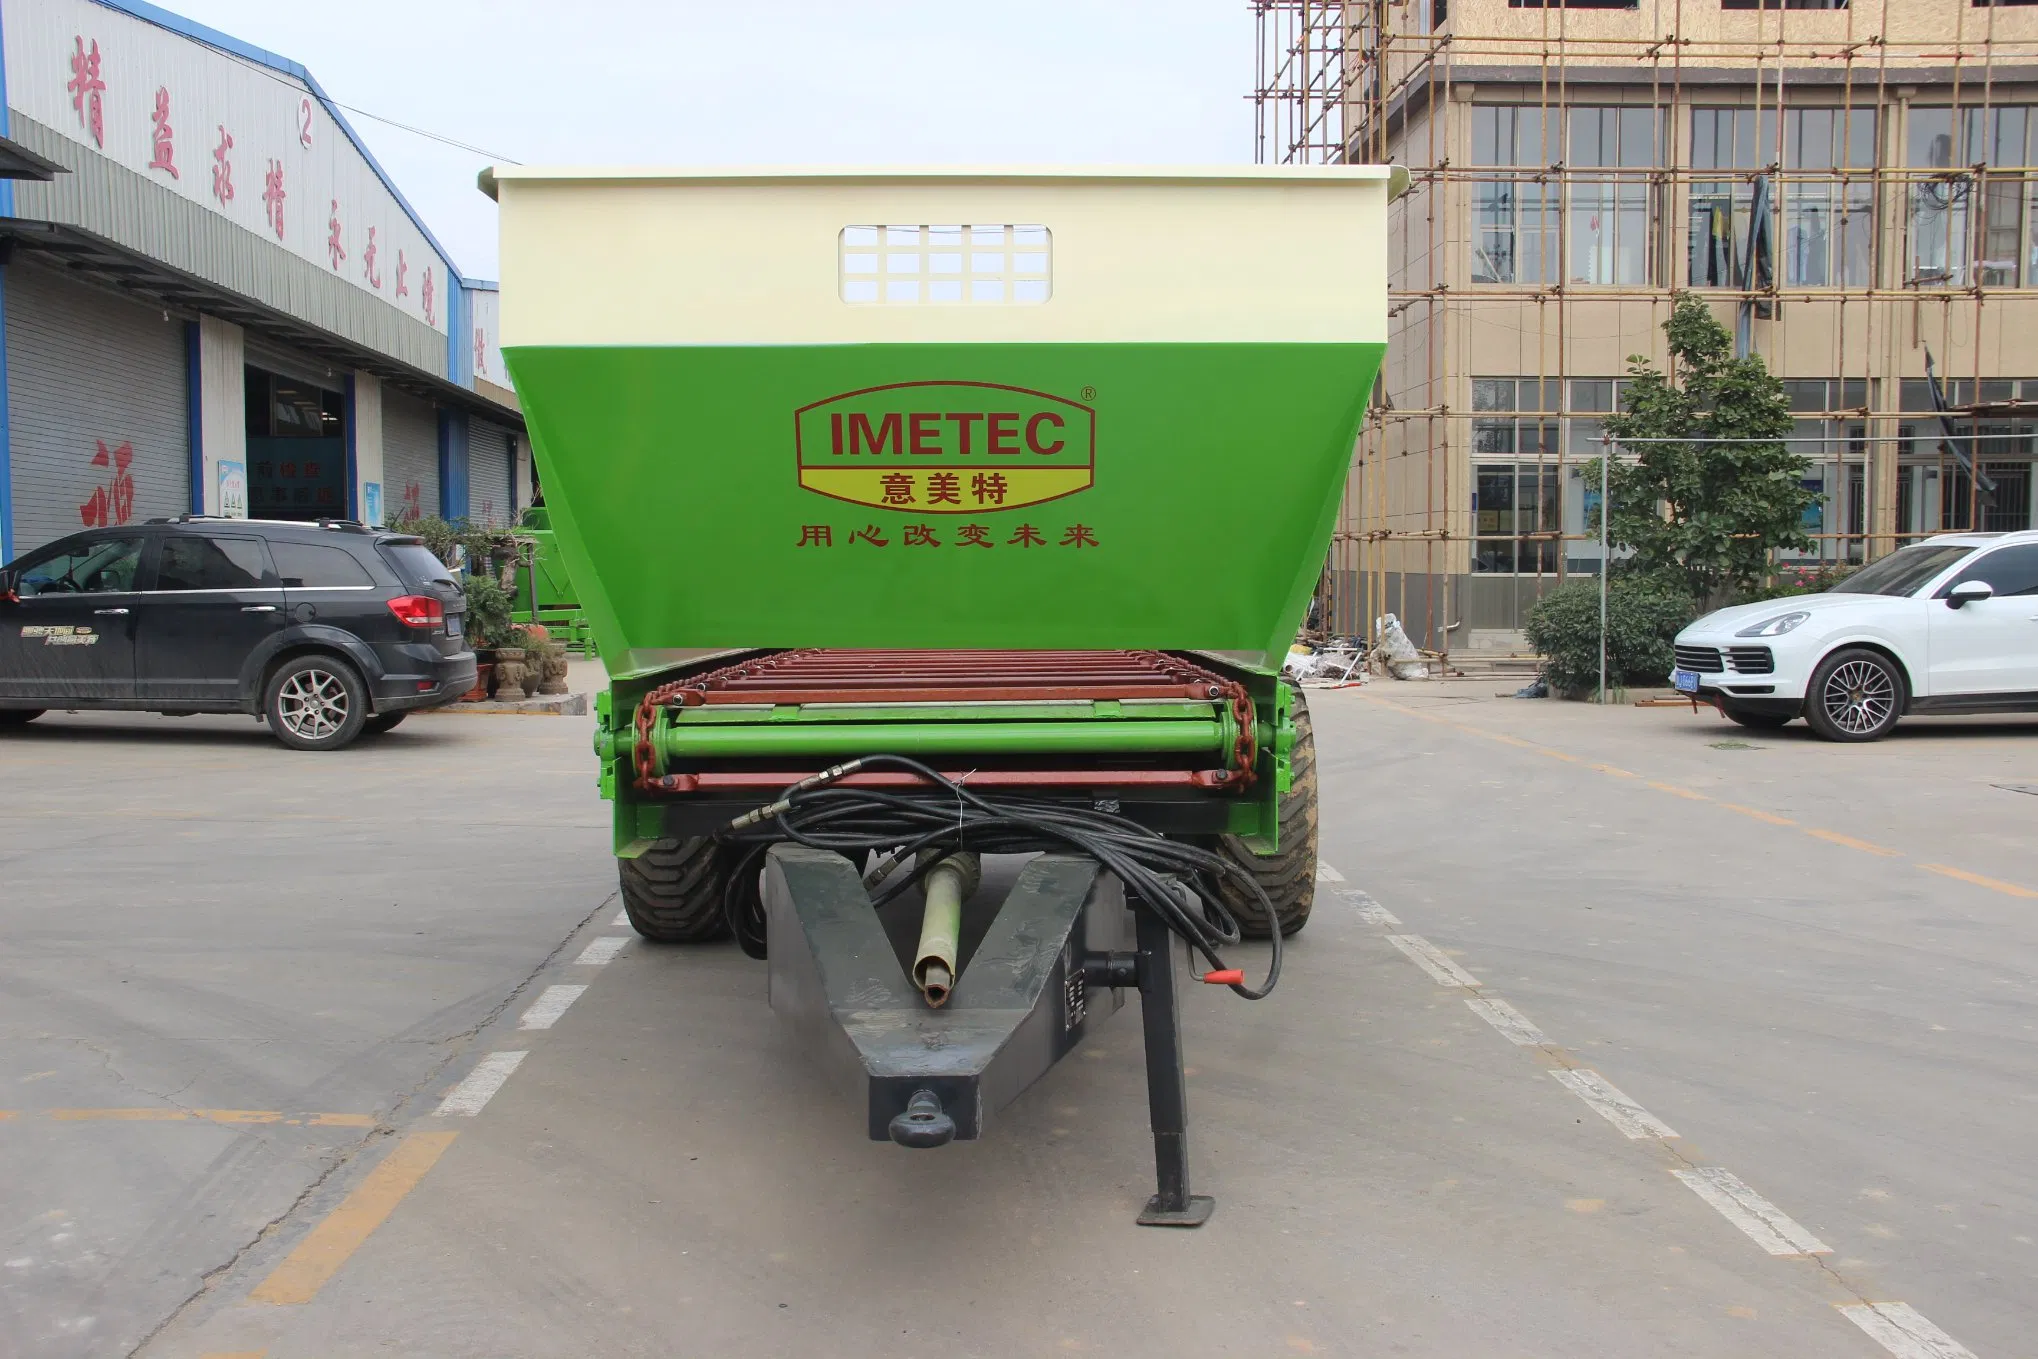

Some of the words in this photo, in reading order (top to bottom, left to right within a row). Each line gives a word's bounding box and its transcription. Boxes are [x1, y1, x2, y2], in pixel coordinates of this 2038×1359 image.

[68, 35, 287, 241] 精益求精
[303, 98, 312, 145] 2
[831, 412, 1065, 455] IMETEC
[880, 472, 1008, 505] 意美特
[796, 523, 1100, 548] 用心改变未来
